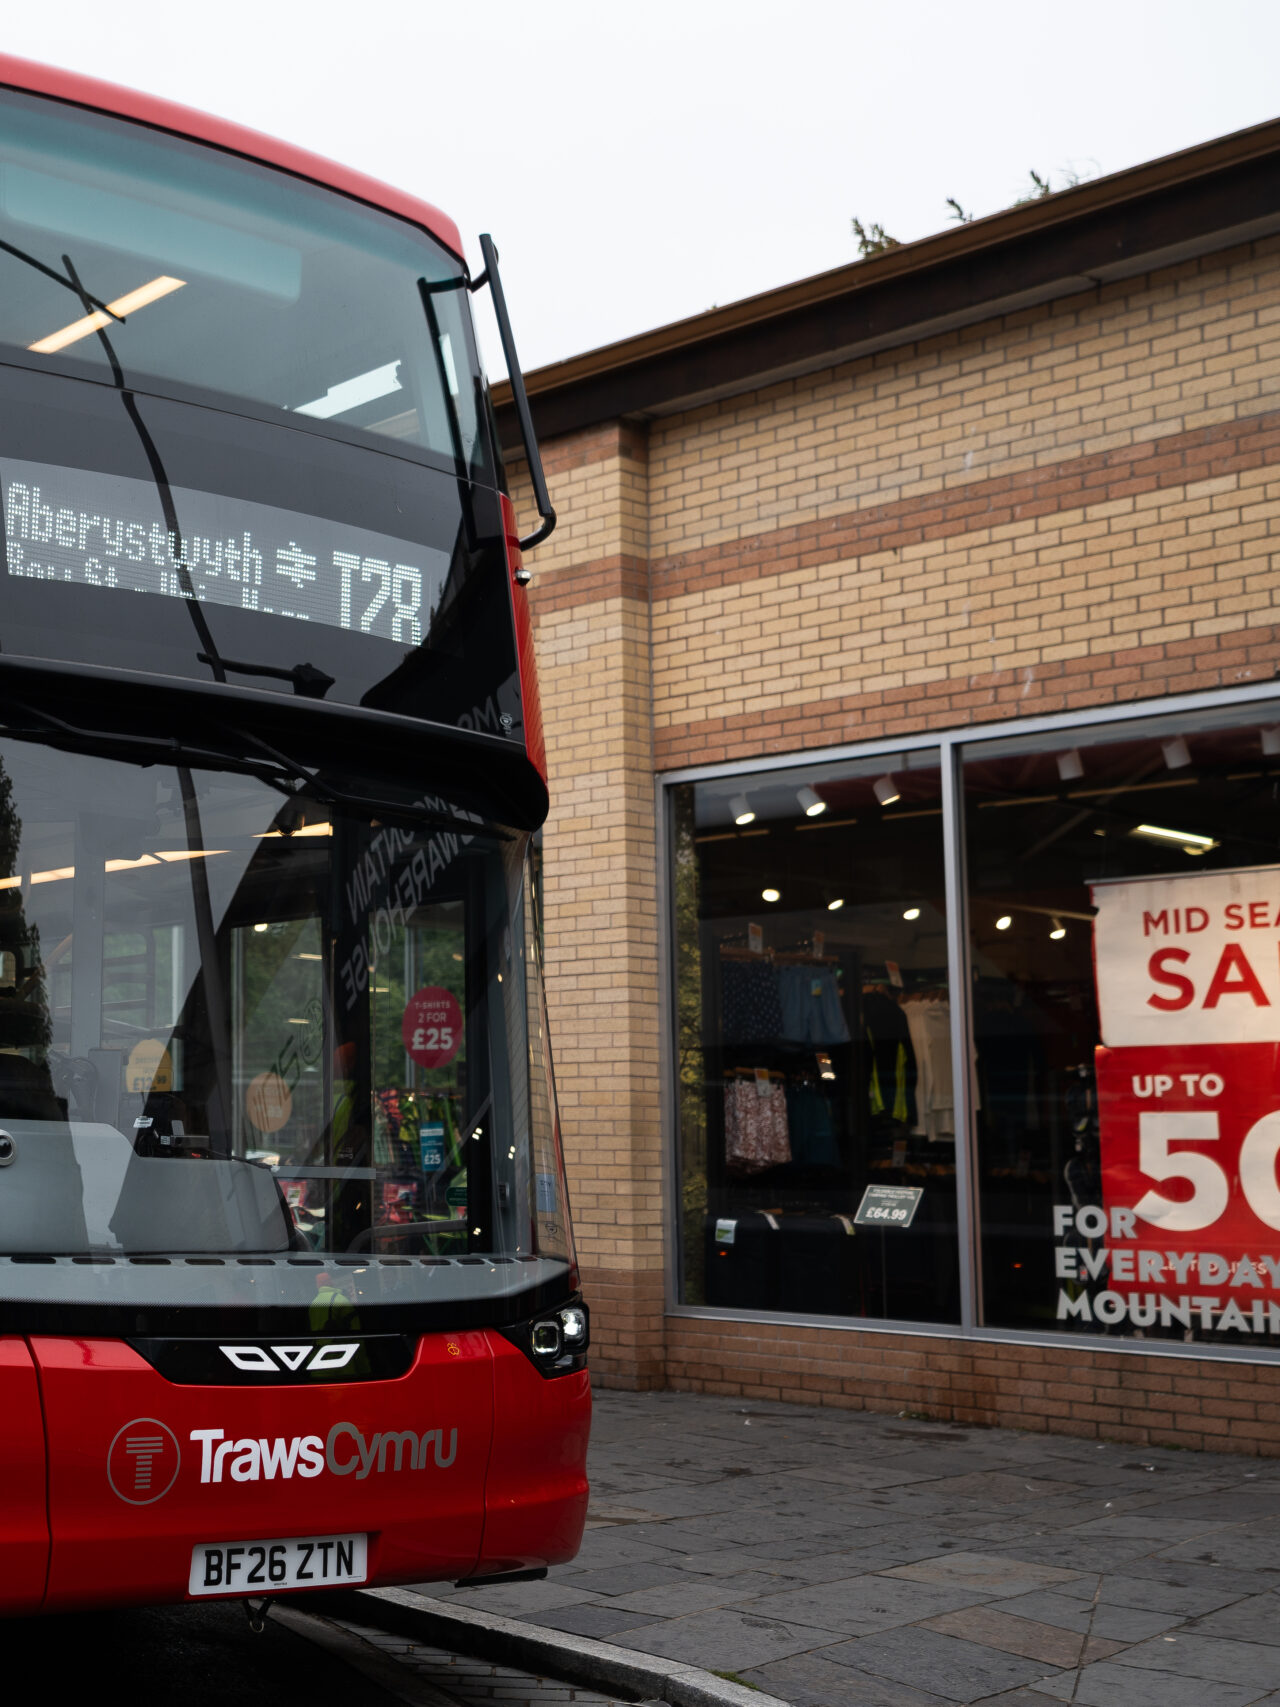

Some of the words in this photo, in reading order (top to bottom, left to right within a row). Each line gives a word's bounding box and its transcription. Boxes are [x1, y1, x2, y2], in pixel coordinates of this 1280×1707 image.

[7, 482, 263, 585] Aberystwyth
[333, 551, 421, 646] T28
[1142, 907, 1210, 938] MID
[1224, 902, 1280, 930] SE
[1146, 943, 1280, 1013] SA
[418, 1013, 424, 1023] 2
[426, 1012, 447, 1023] FOR
[411, 1027, 453, 1051] £25
[1132, 1075, 1173, 1098] UP
[1180, 1074, 1224, 1097] TO
[865, 1206, 908, 1220] £64.99
[1053, 1205, 1137, 1239] FOR
[190, 1421, 458, 1483] TrawsCymru
[204, 1546, 287, 1586] BF26
[296, 1540, 354, 1580] ZTN
